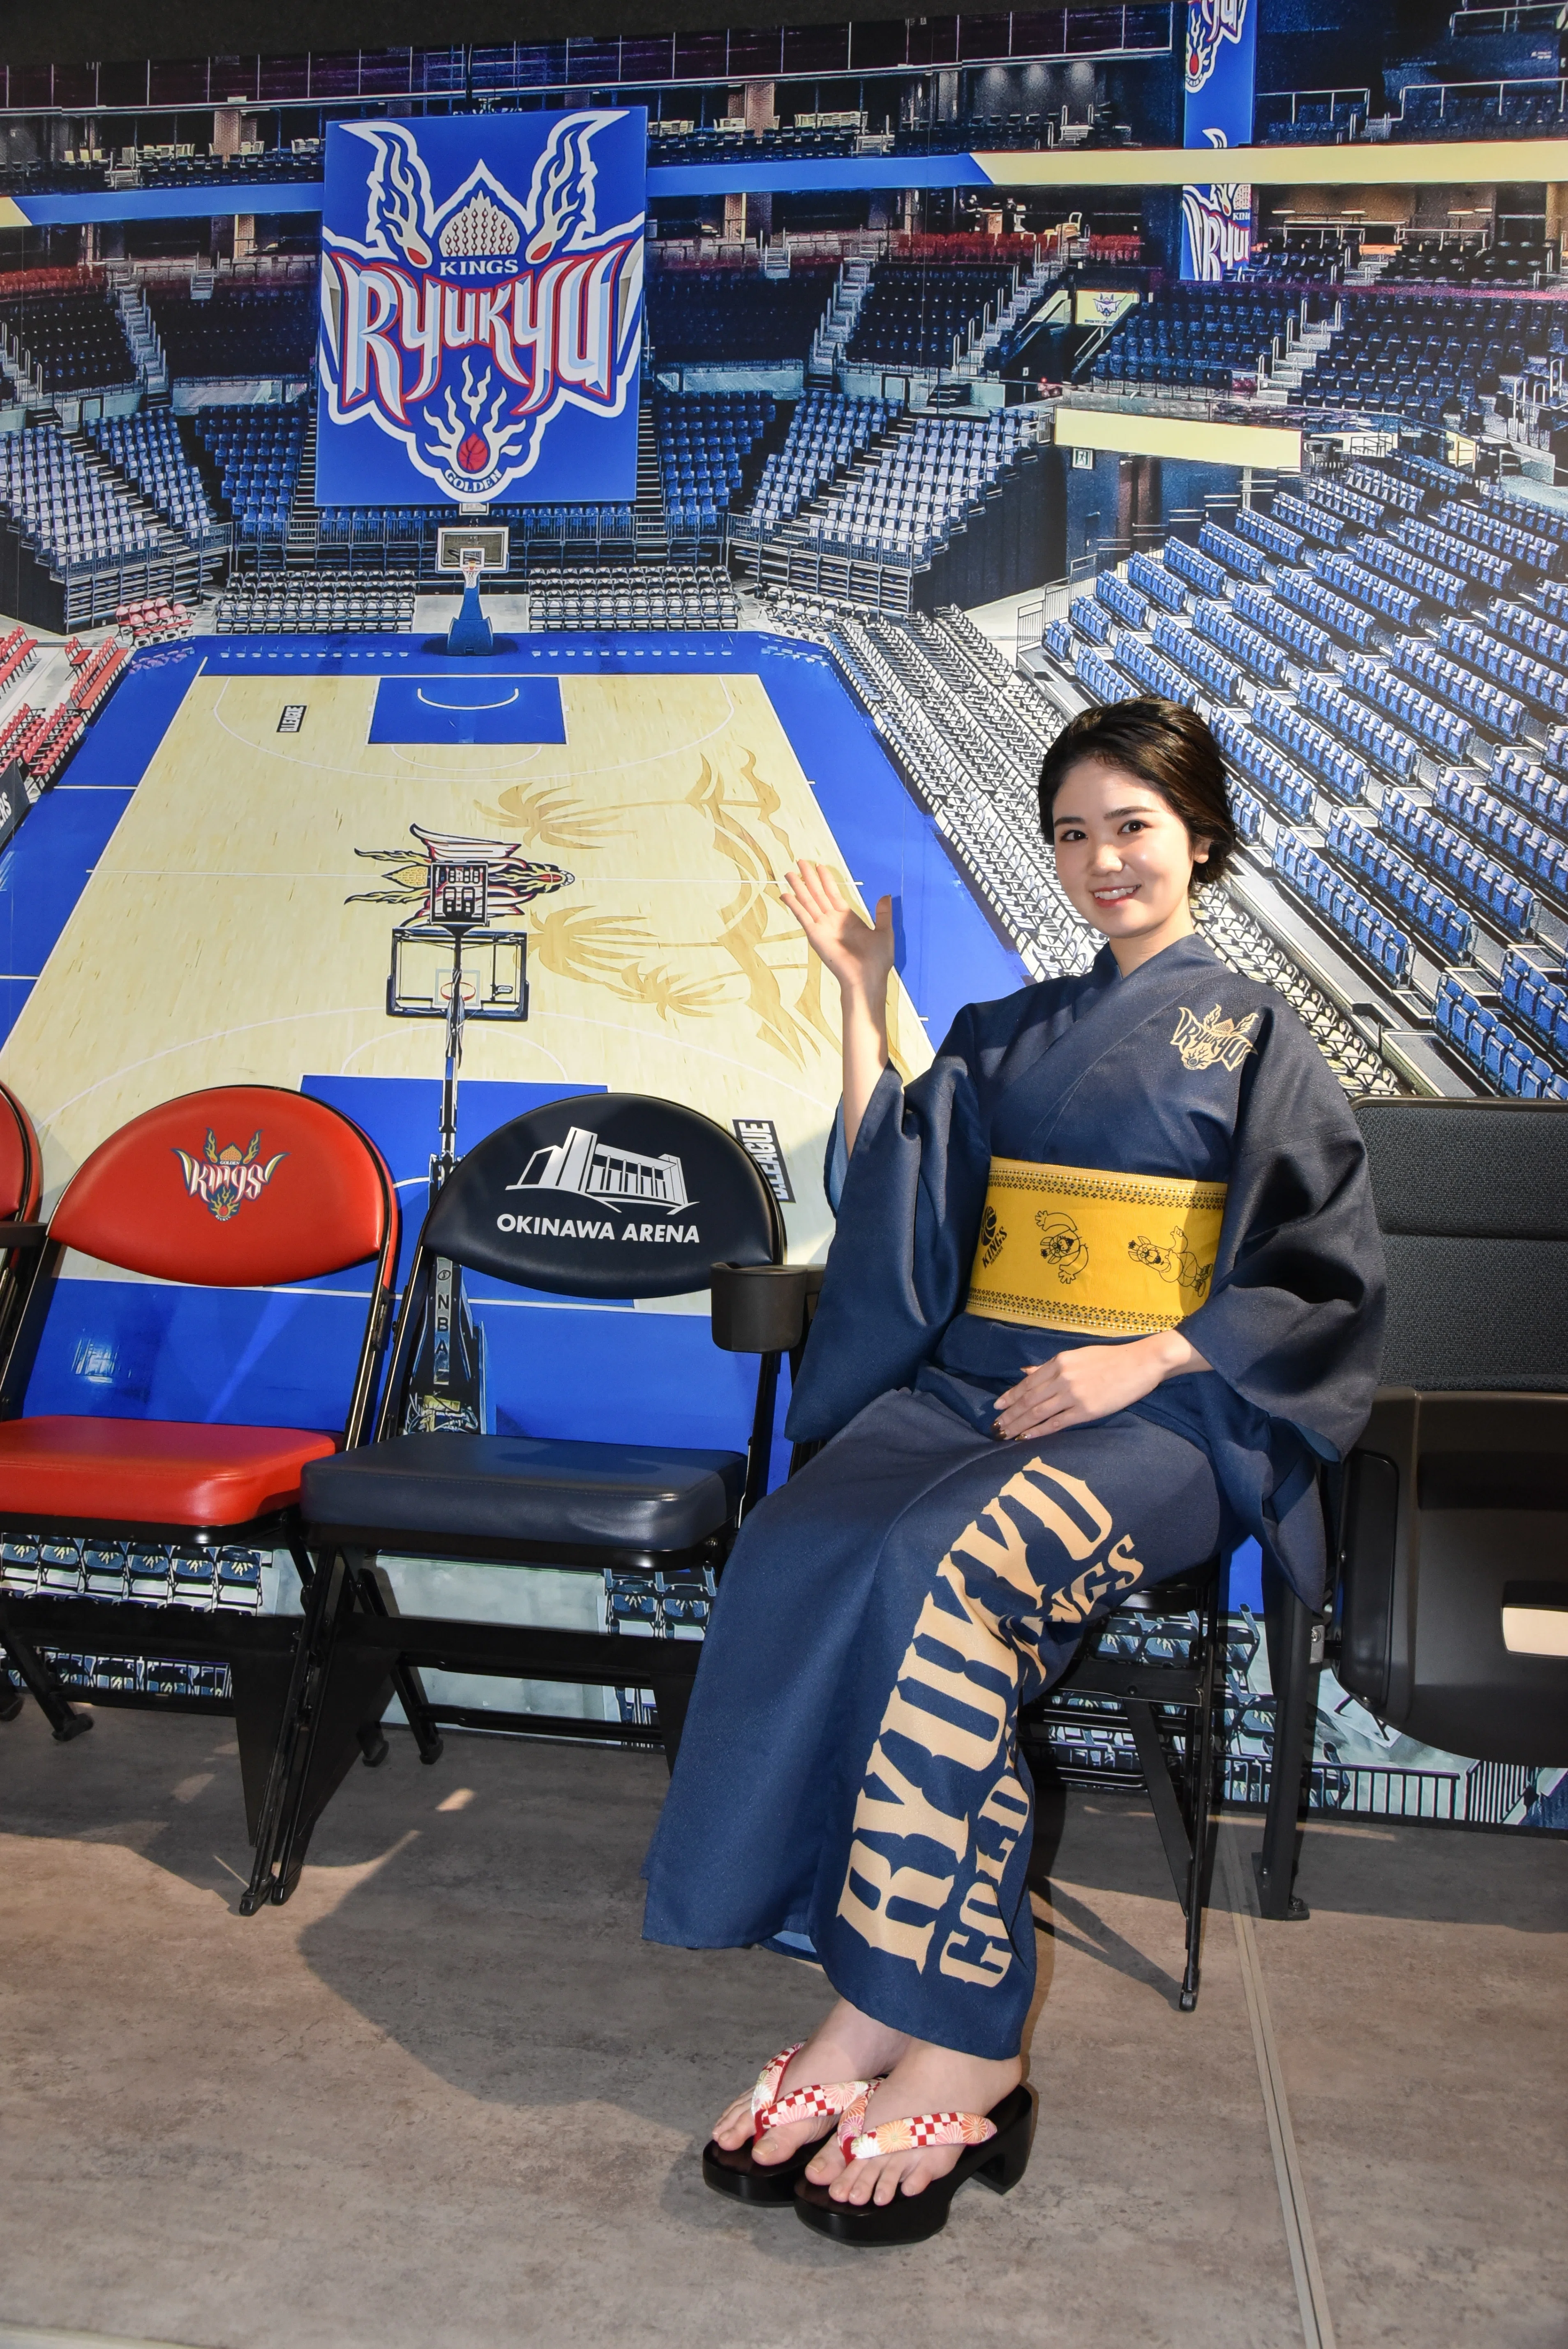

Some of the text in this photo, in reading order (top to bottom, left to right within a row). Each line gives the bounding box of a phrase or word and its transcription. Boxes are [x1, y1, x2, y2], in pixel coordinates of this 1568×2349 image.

[1233, 212, 1251, 220] KIN
[439, 259, 519, 276] KINGS
[336, 240, 633, 425] RYUKYU
[444, 468, 502, 492] GOLDEN
[496, 1213, 700, 1243] OKINAWA ARENA
[982, 1226, 1007, 1269] KINGS
[435, 1294, 449, 1354] NBA
[836, 1456, 1113, 1975] RYUKYU
